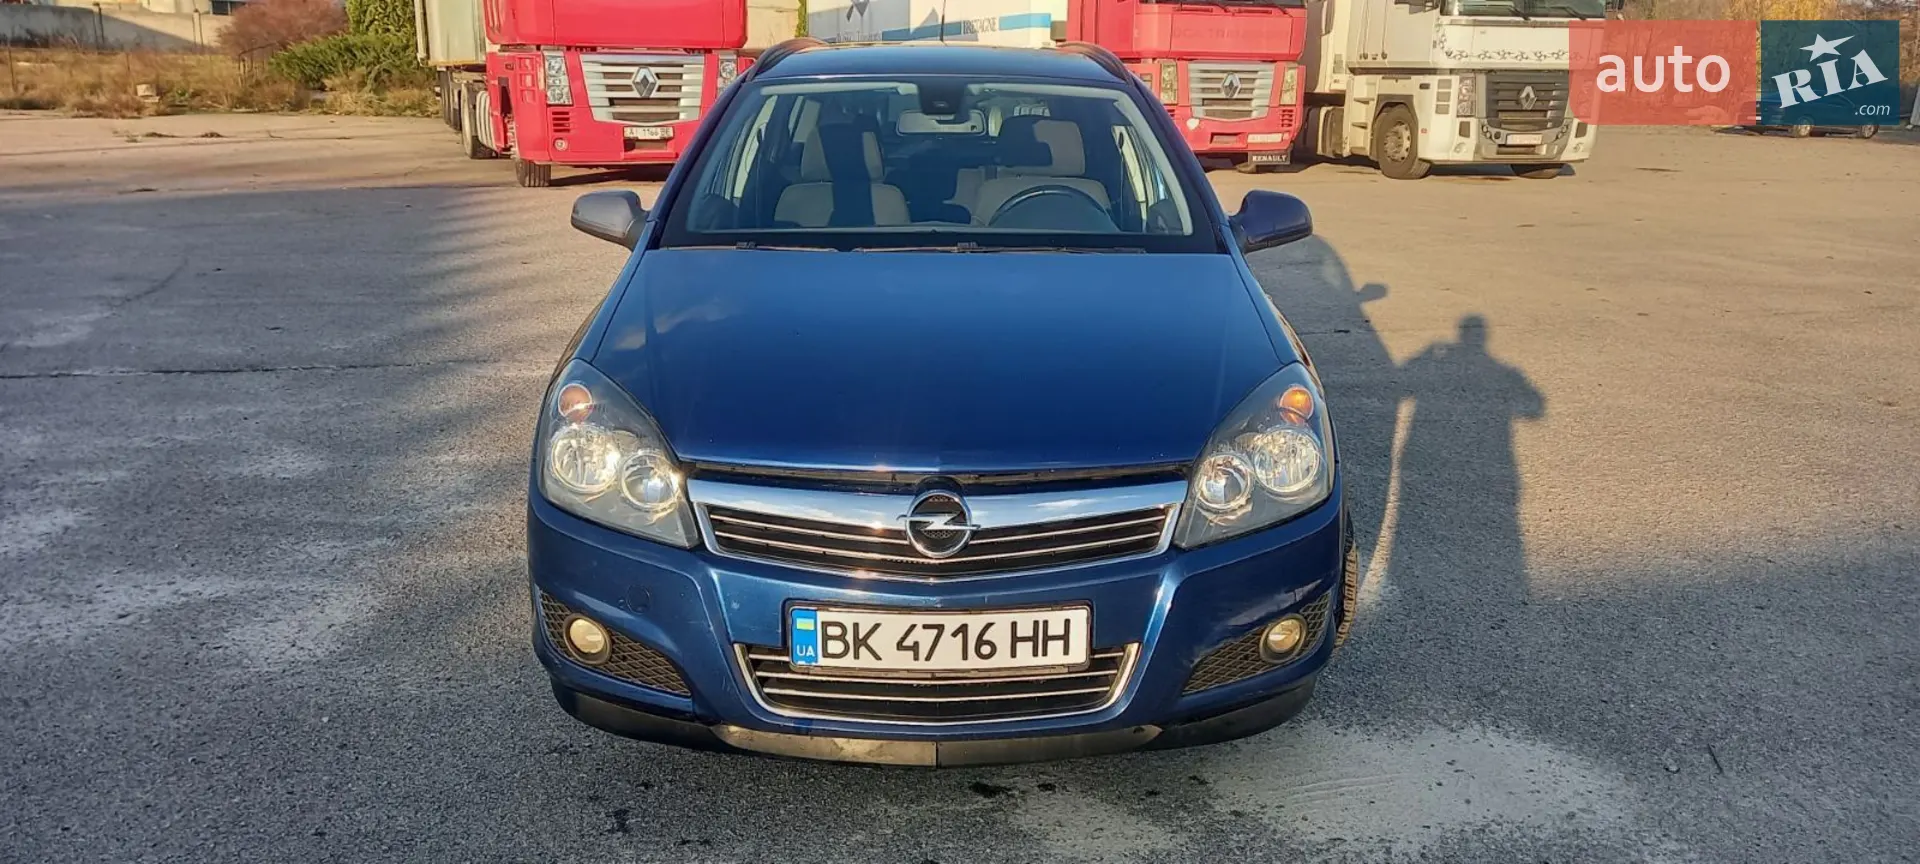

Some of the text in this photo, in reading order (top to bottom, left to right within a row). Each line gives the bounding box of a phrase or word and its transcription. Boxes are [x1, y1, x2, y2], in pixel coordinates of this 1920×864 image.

[796, 644, 815, 657] UA
[820, 618, 1070, 662] BK 4716 HH
